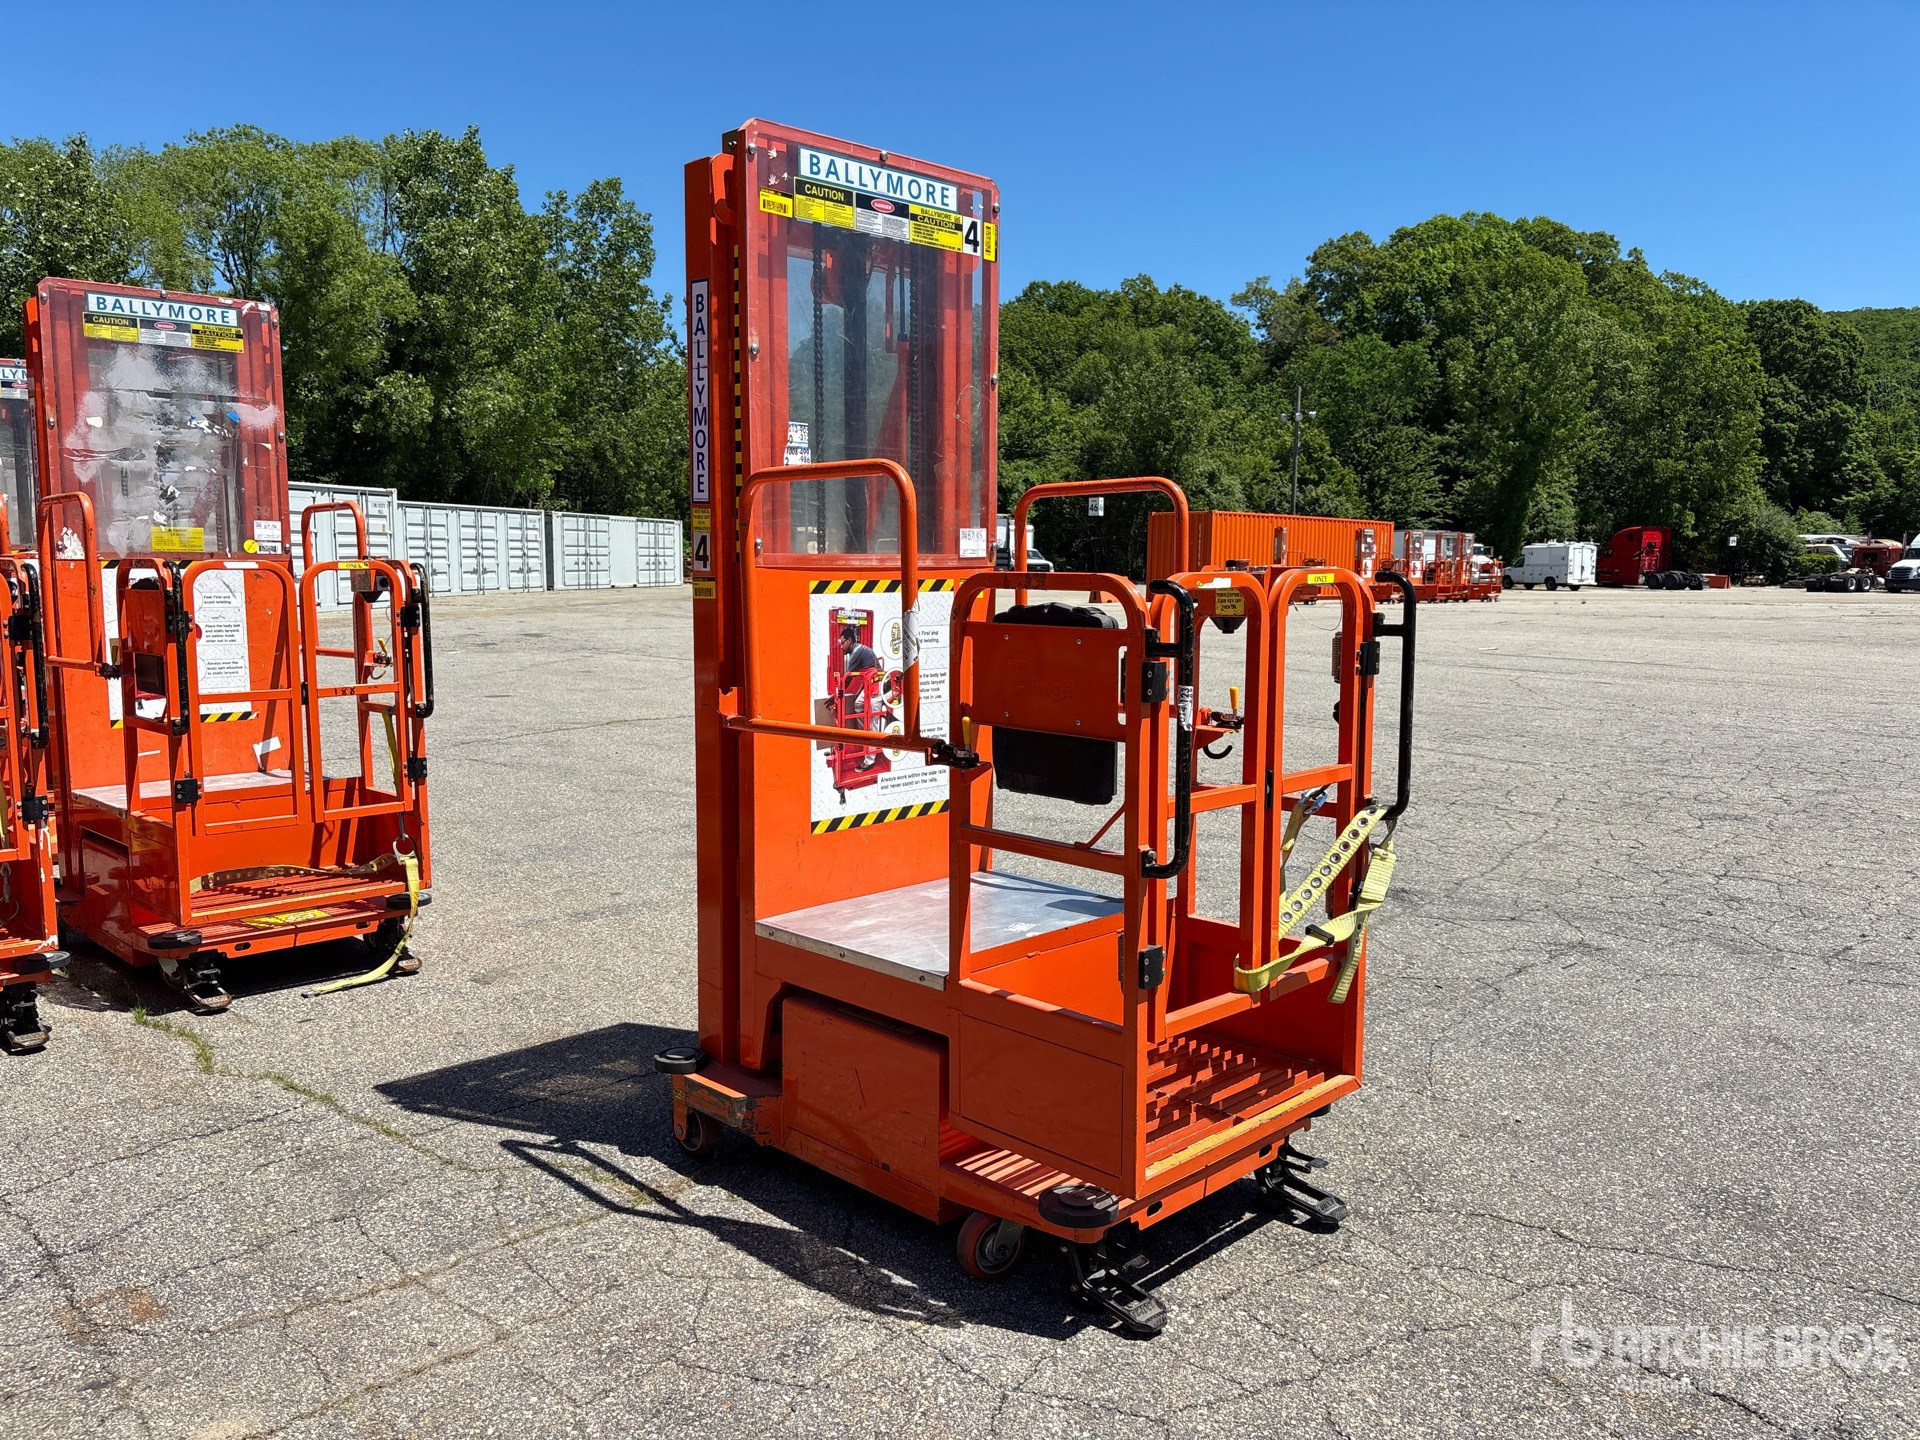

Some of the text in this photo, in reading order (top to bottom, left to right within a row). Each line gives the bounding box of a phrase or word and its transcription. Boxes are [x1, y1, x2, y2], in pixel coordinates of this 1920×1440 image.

[809, 153, 950, 207] BALLYMORE
[804, 184, 845, 202] CAUTION
[917, 216, 956, 230] CAUTION
[920, 208, 952, 220] BALLYMORE
[964, 220, 980, 254] 4
[96, 296, 230, 324] BALLYMORE
[92, 316, 129, 326] CAUTION
[198, 330, 236, 338] CAUTION
[694, 293, 707, 493] BALLYMORE
[1090, 504, 1098, 512] 46
[695, 535, 709, 568] 4
